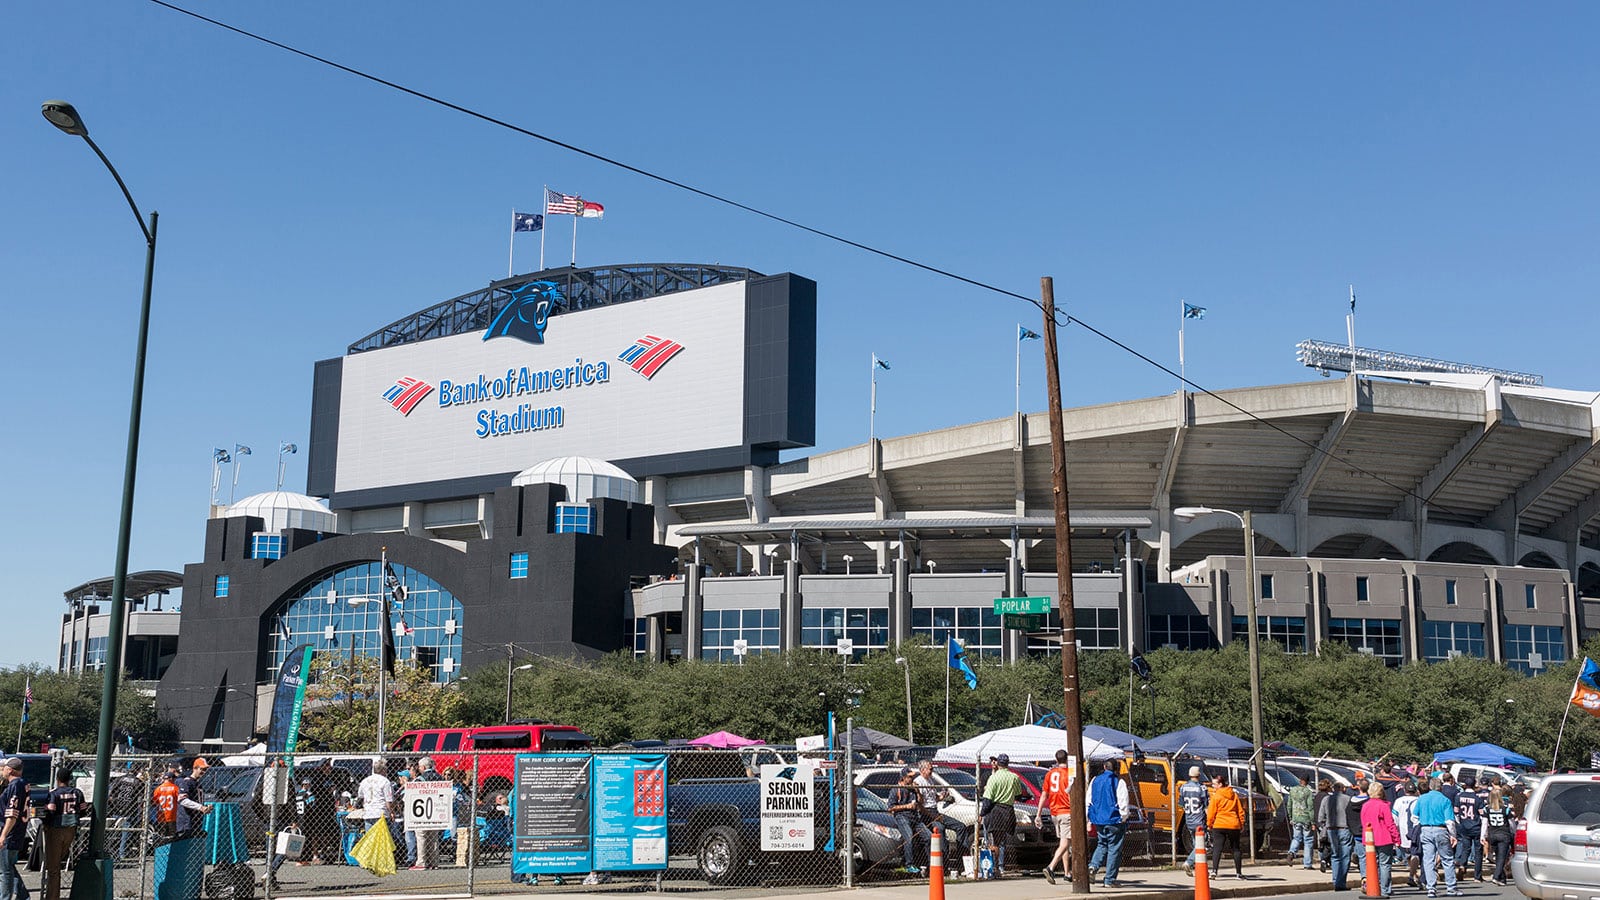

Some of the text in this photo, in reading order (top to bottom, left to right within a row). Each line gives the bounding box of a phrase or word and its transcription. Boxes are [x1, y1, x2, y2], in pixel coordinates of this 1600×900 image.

[475, 403, 564, 438] Stadium
[1001, 600, 1031, 612] POPLAR
[287, 700, 302, 744] TAILGATING
[768, 781, 806, 796] SEASON
[1050, 771, 1060, 793] 9
[159, 795, 174, 811] 23
[412, 796, 433, 820] 60
[766, 796, 809, 810] PARKING
[1460, 805, 1475, 820] 34
[1489, 813, 1504, 827] 59
